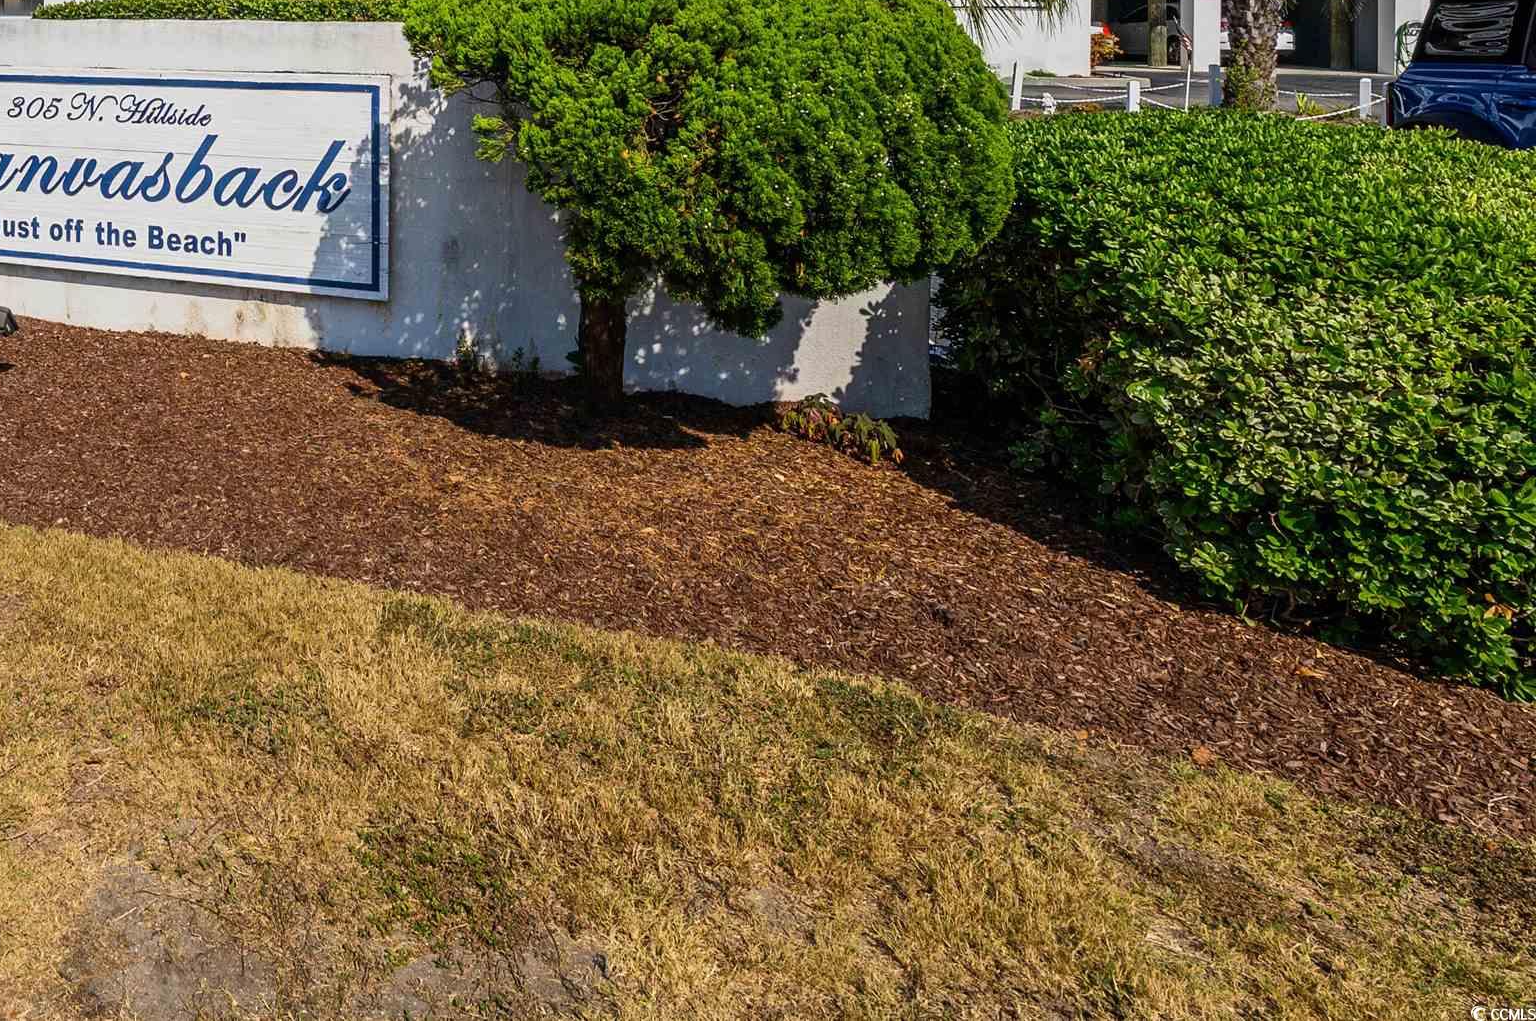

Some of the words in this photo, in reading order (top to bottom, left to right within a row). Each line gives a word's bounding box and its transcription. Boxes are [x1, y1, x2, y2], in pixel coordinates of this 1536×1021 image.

[7, 96, 63, 120] 305
[67, 92, 119, 122] N.
[115, 94, 212, 127] Hillside
[49, 218, 84, 243] off
[95, 221, 137, 248] the
[147, 225, 247, 257] Beach"
